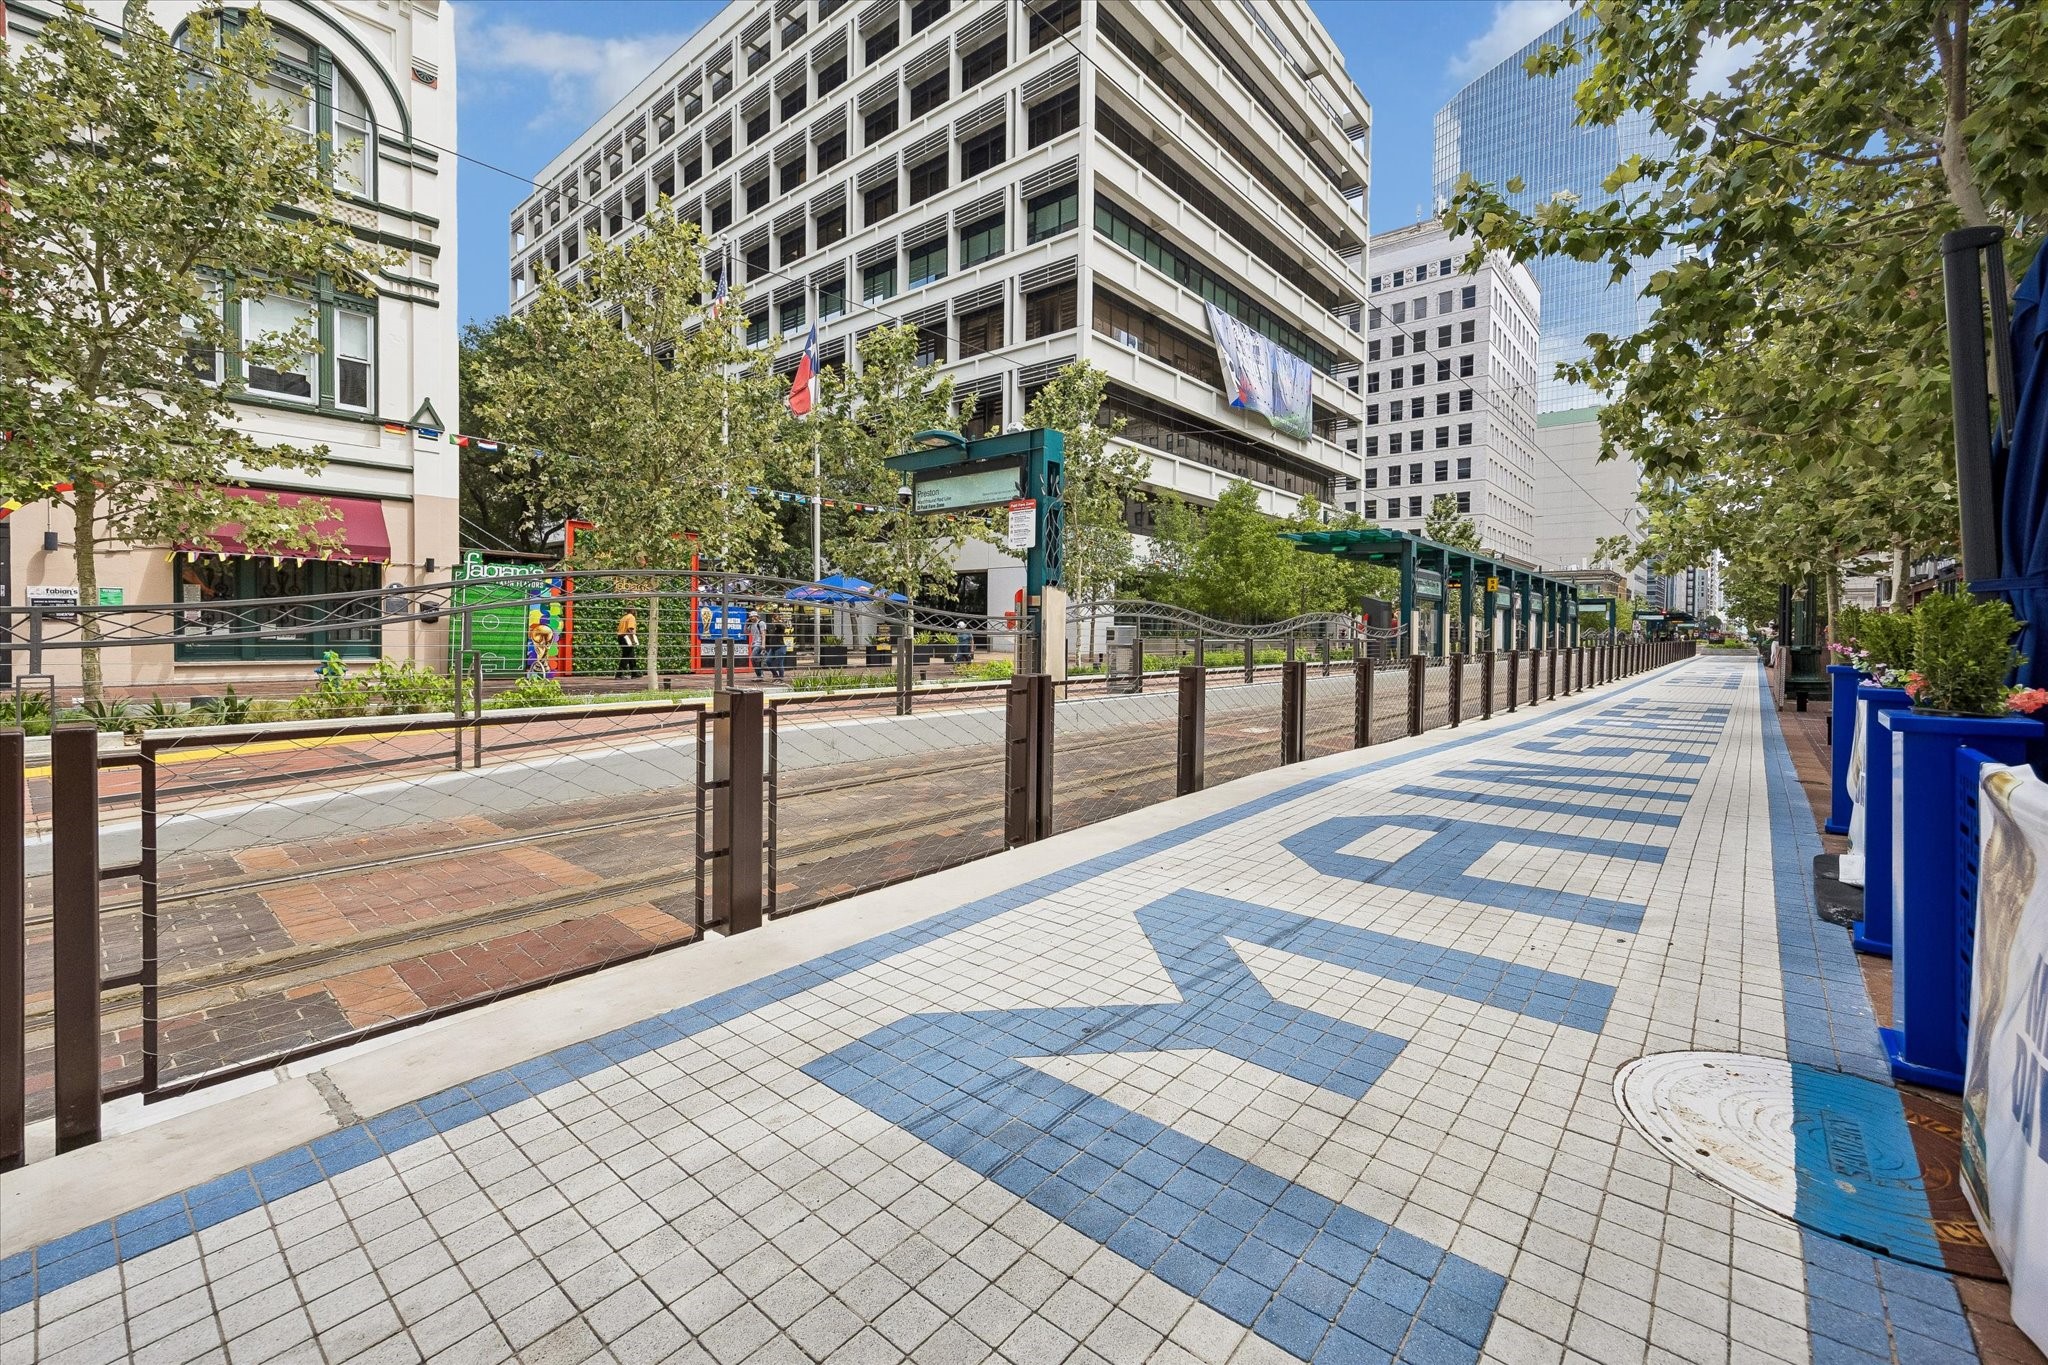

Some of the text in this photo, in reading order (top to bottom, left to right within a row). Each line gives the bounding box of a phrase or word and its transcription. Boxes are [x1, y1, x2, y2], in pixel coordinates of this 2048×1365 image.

[917, 489, 940, 498] Preston
[464, 552, 544, 580] fabian's
[46, 588, 78, 596] fabian's
[802, 757, 1700, 1365] MAIN
